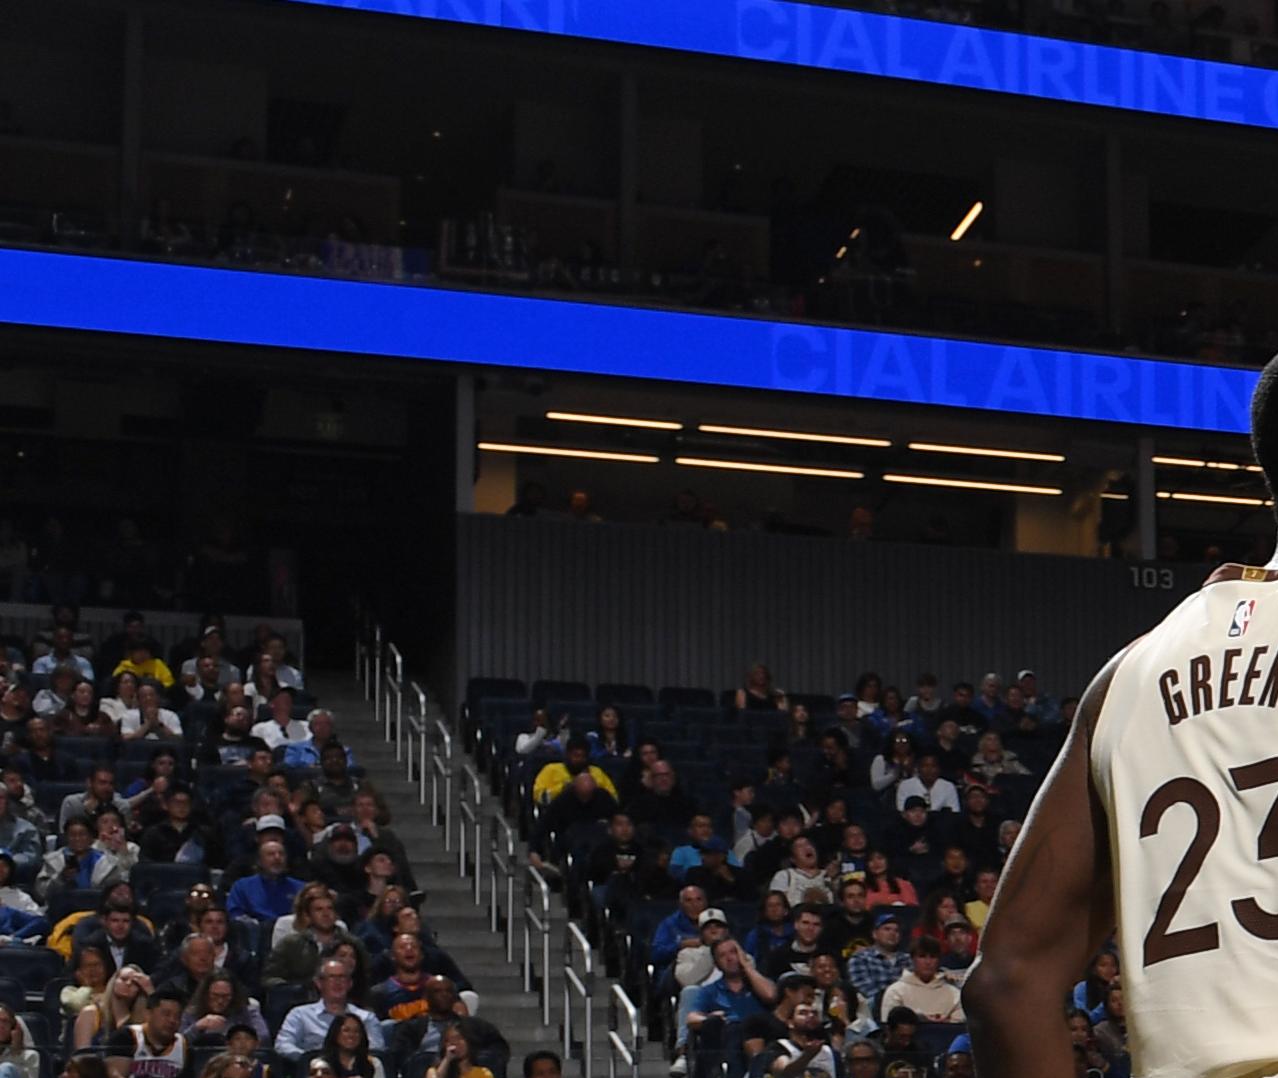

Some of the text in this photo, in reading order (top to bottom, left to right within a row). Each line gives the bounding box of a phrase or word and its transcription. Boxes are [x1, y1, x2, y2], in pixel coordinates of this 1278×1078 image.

[938, 26, 1245, 122] AIRLINE
[984, 346, 1253, 432] AIRLIN
[1130, 566, 1174, 589] 103
